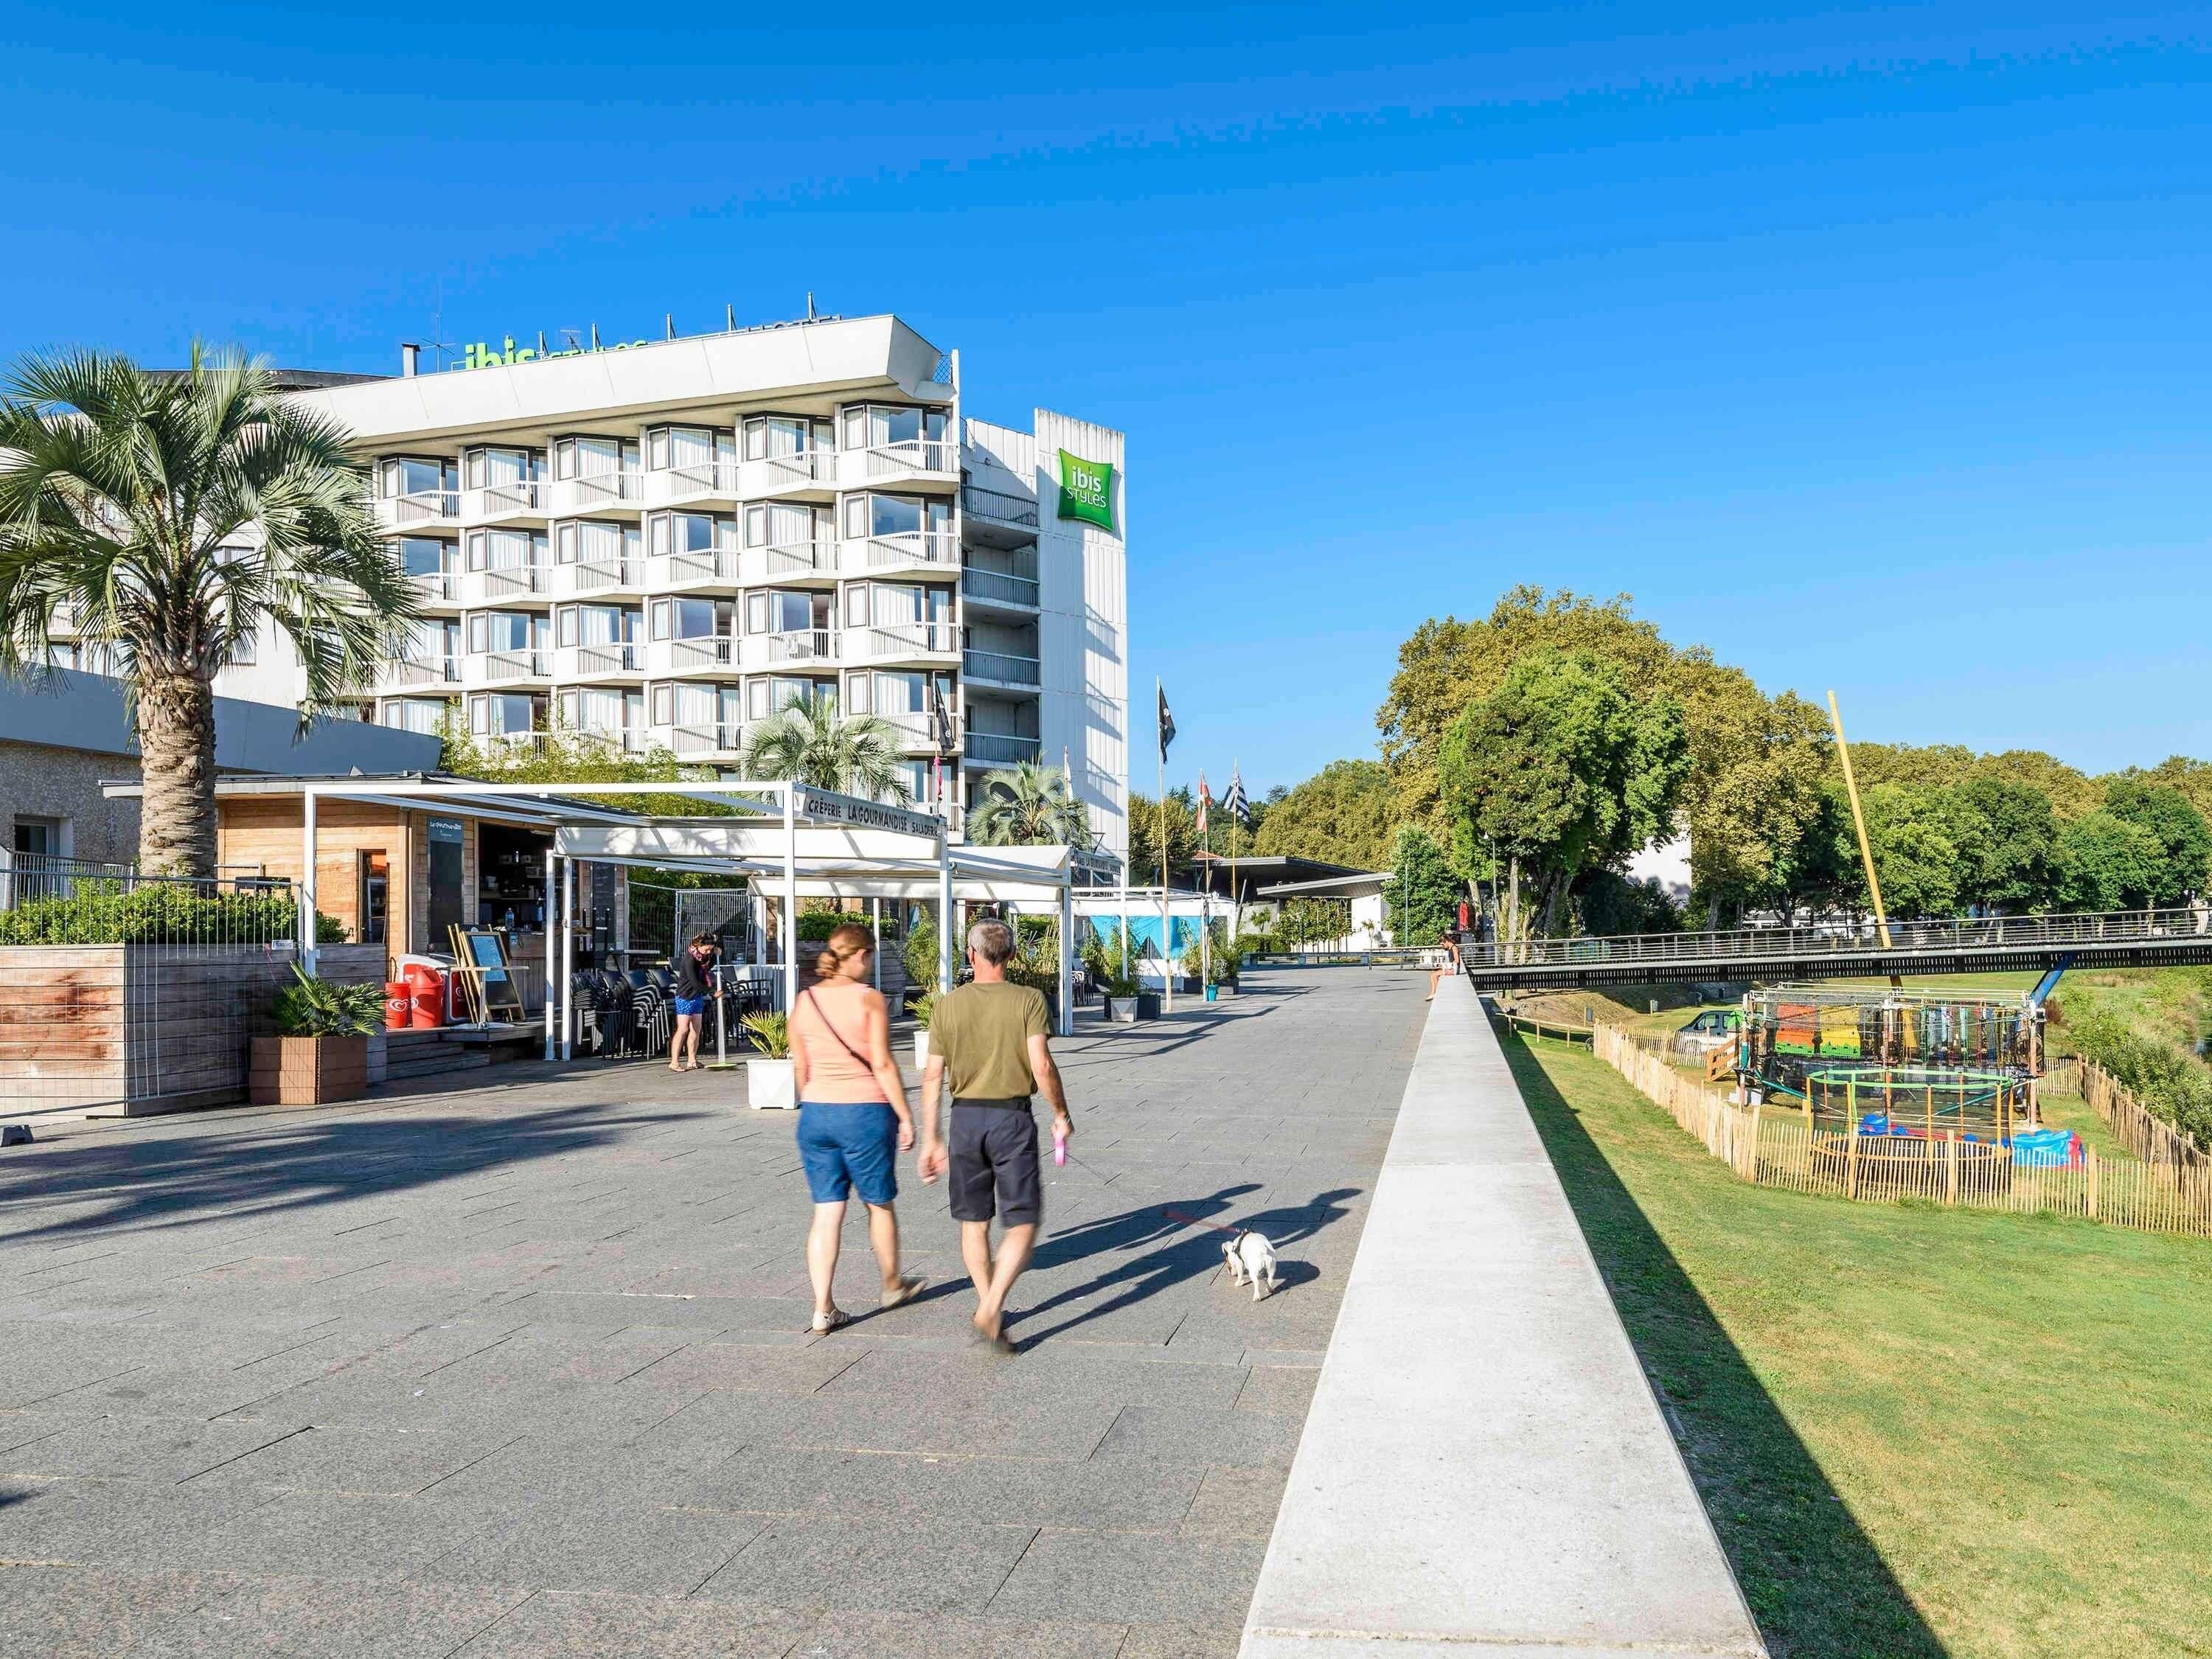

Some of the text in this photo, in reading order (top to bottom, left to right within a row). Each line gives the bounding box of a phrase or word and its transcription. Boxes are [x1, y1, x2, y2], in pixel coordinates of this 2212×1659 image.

[1072, 466, 1102, 493] ibis
[808, 797, 842, 818] CRÊPERIE
[848, 804, 858, 821] LA
[858, 806, 907, 832] GOURMANDISE
